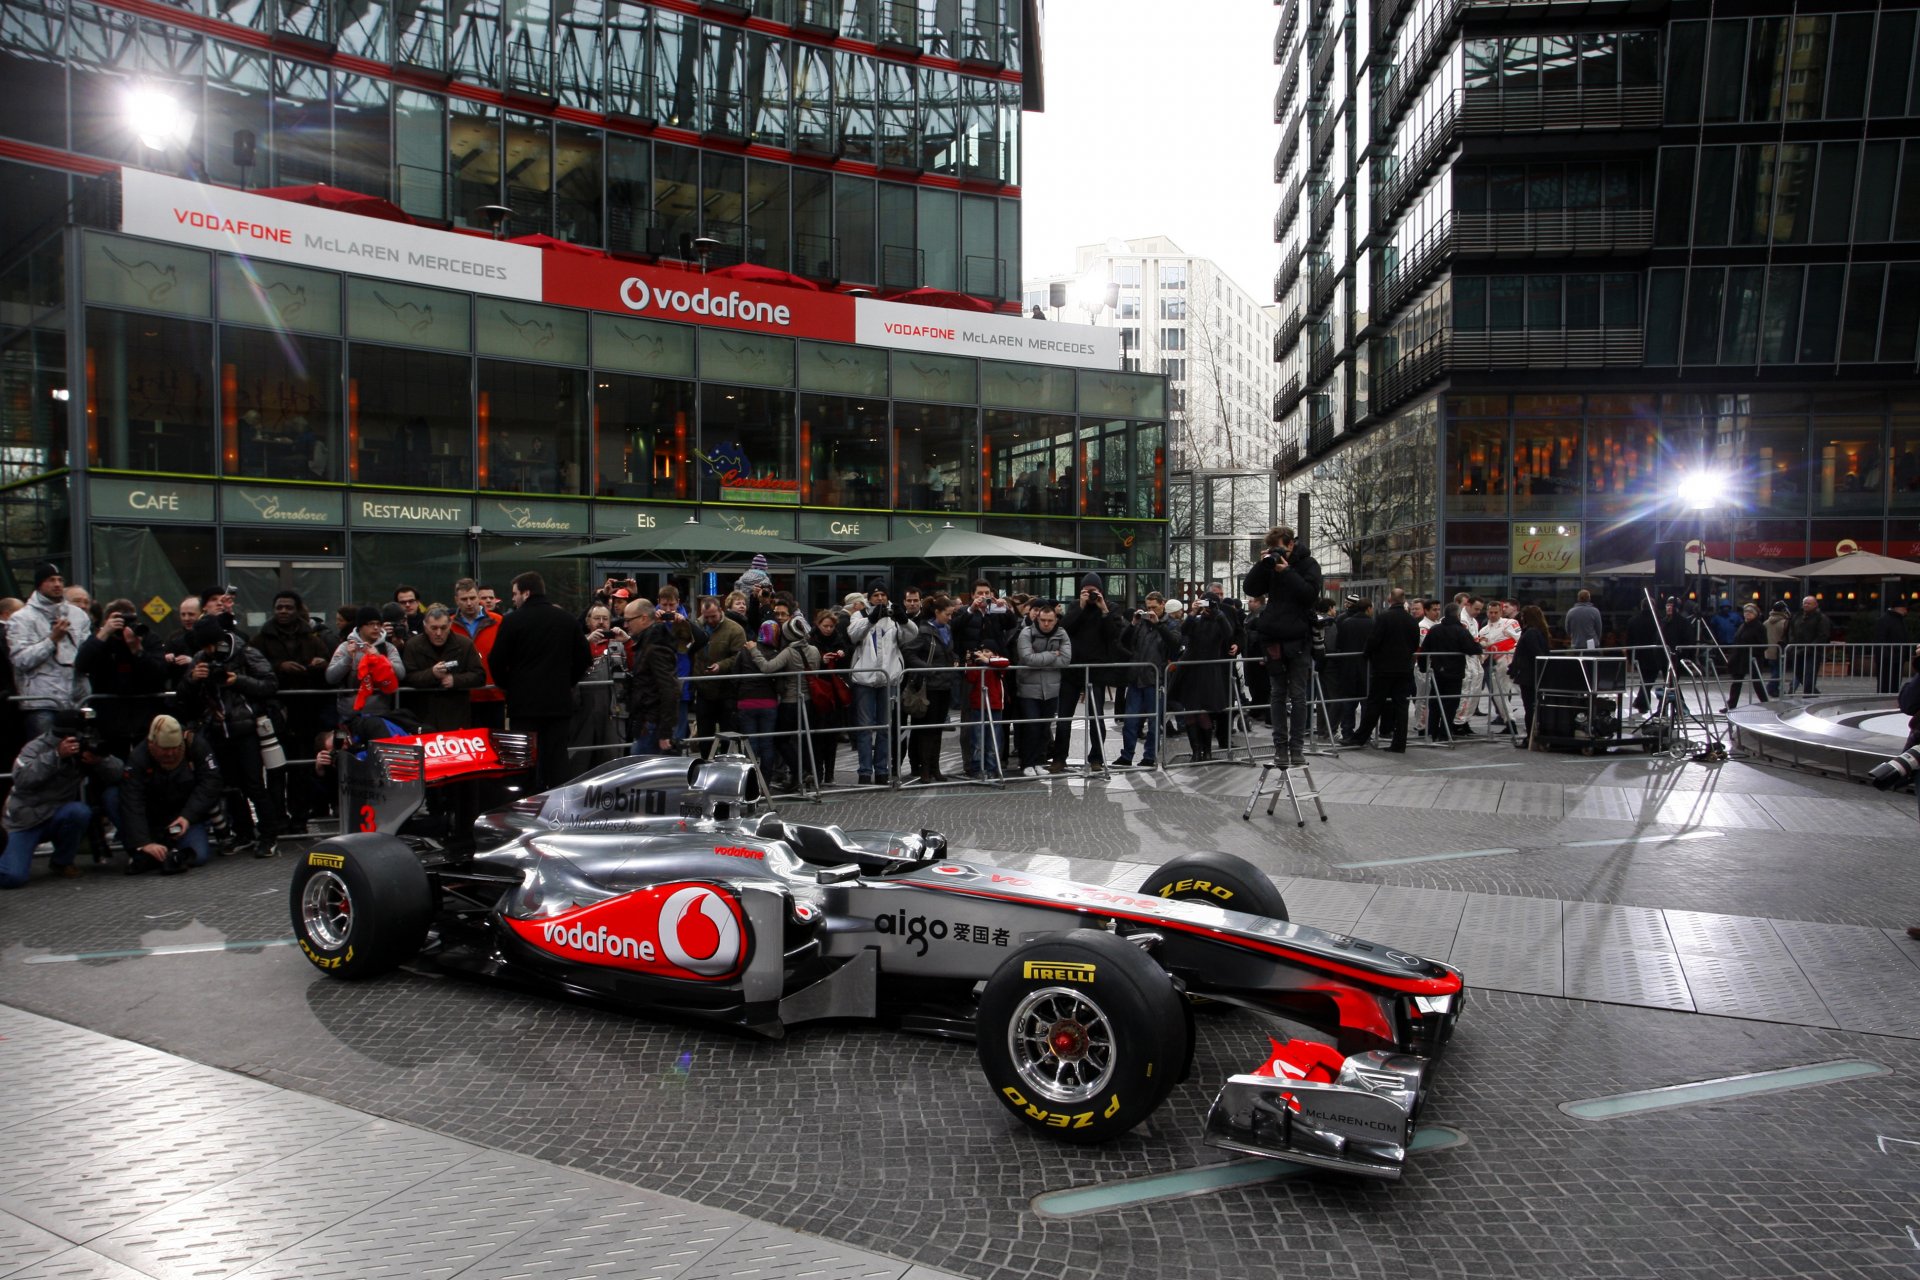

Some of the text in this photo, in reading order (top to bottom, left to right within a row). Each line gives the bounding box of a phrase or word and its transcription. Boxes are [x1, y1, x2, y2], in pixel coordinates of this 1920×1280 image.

[174, 208, 507, 280] VODAFONE McLAREN MERCEDES
[653, 287, 790, 325] vodafone
[884, 322, 1095, 355] VODAFONE McLAREN MERCEDES
[129, 491, 179, 511] CAFÉ
[362, 502, 462, 521] RESTAURANT
[263, 505, 328, 521] Corroboree
[517, 516, 571, 530] Corroboree
[830, 521, 860, 536] CAFÉ
[584, 784, 642, 814] Mobil
[359, 804, 377, 832] 3
[568, 813, 650, 833] Mercedes-Benz
[308, 853, 345, 869] PIRELLI
[714, 845, 765, 860] vodafone
[1158, 878, 1235, 900] ZERO
[543, 921, 656, 961] vodafone
[875, 908, 948, 957] aigo
[953, 922, 1011, 947] 爱国者
[1023, 960, 1097, 983] PIRELLI
[1002, 1086, 1121, 1129] P ZERO
